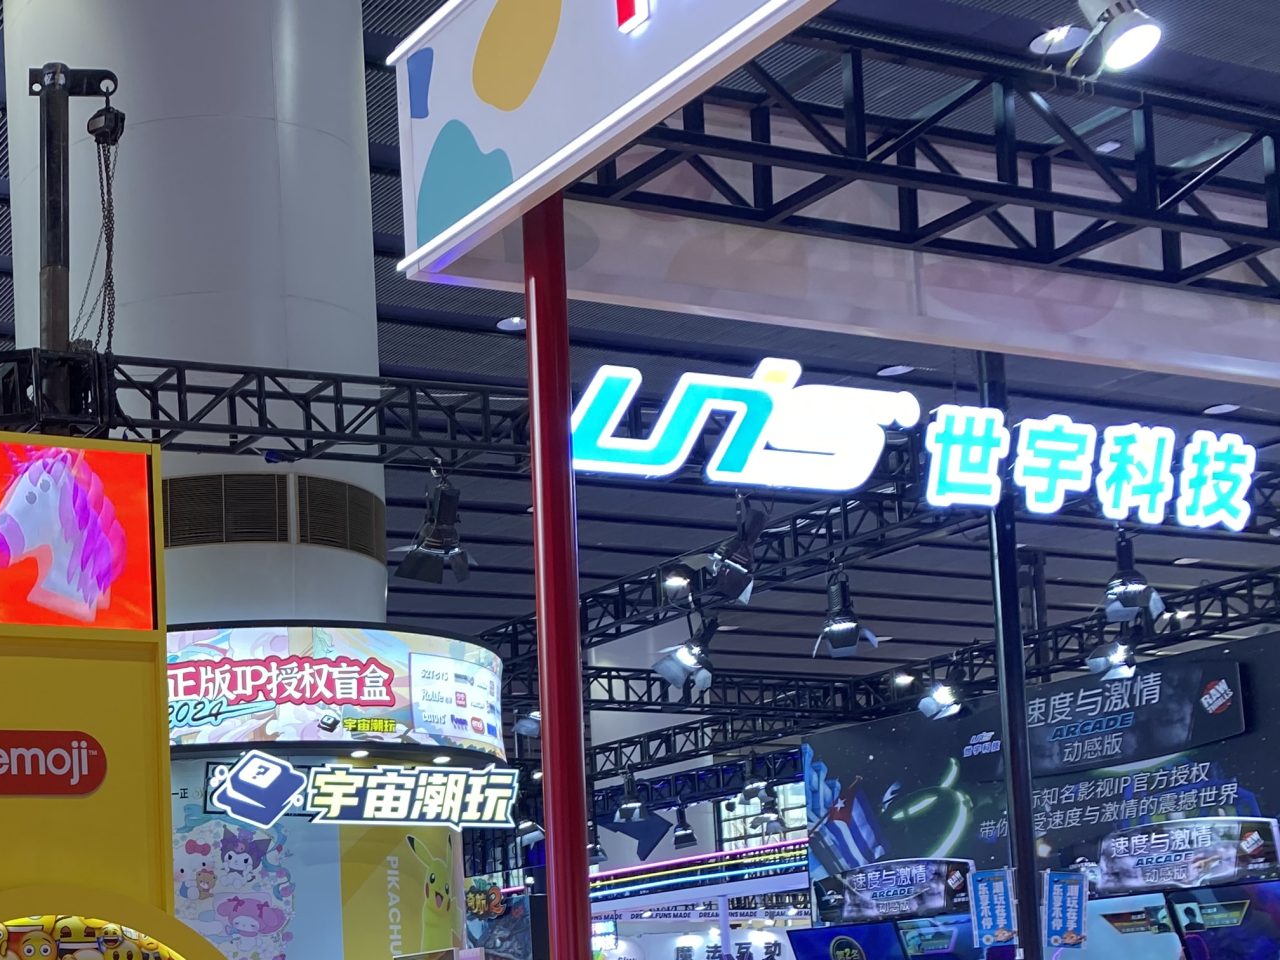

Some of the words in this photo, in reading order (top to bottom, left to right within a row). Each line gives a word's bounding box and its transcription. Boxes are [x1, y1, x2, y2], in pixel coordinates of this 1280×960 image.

[926, 405, 1256, 532] 世宇科技
[167, 661, 391, 701] 正版IP授权盲盒
[1028, 672, 1162, 728] 速度与激情
[343, 717, 396, 733] 宇宙潮玩
[1049, 712, 1134, 741] ARCADE
[1063, 733, 1122, 763] 动感版
[313, 769, 515, 823] 宇宙潮玩
[1111, 827, 1213, 858] 速度与激情
[1135, 853, 1193, 866] ARCADE
[851, 866, 927, 891] 速度与激情
[872, 888, 914, 899] ARCADE
[386, 856, 402, 955] PIKACHU
